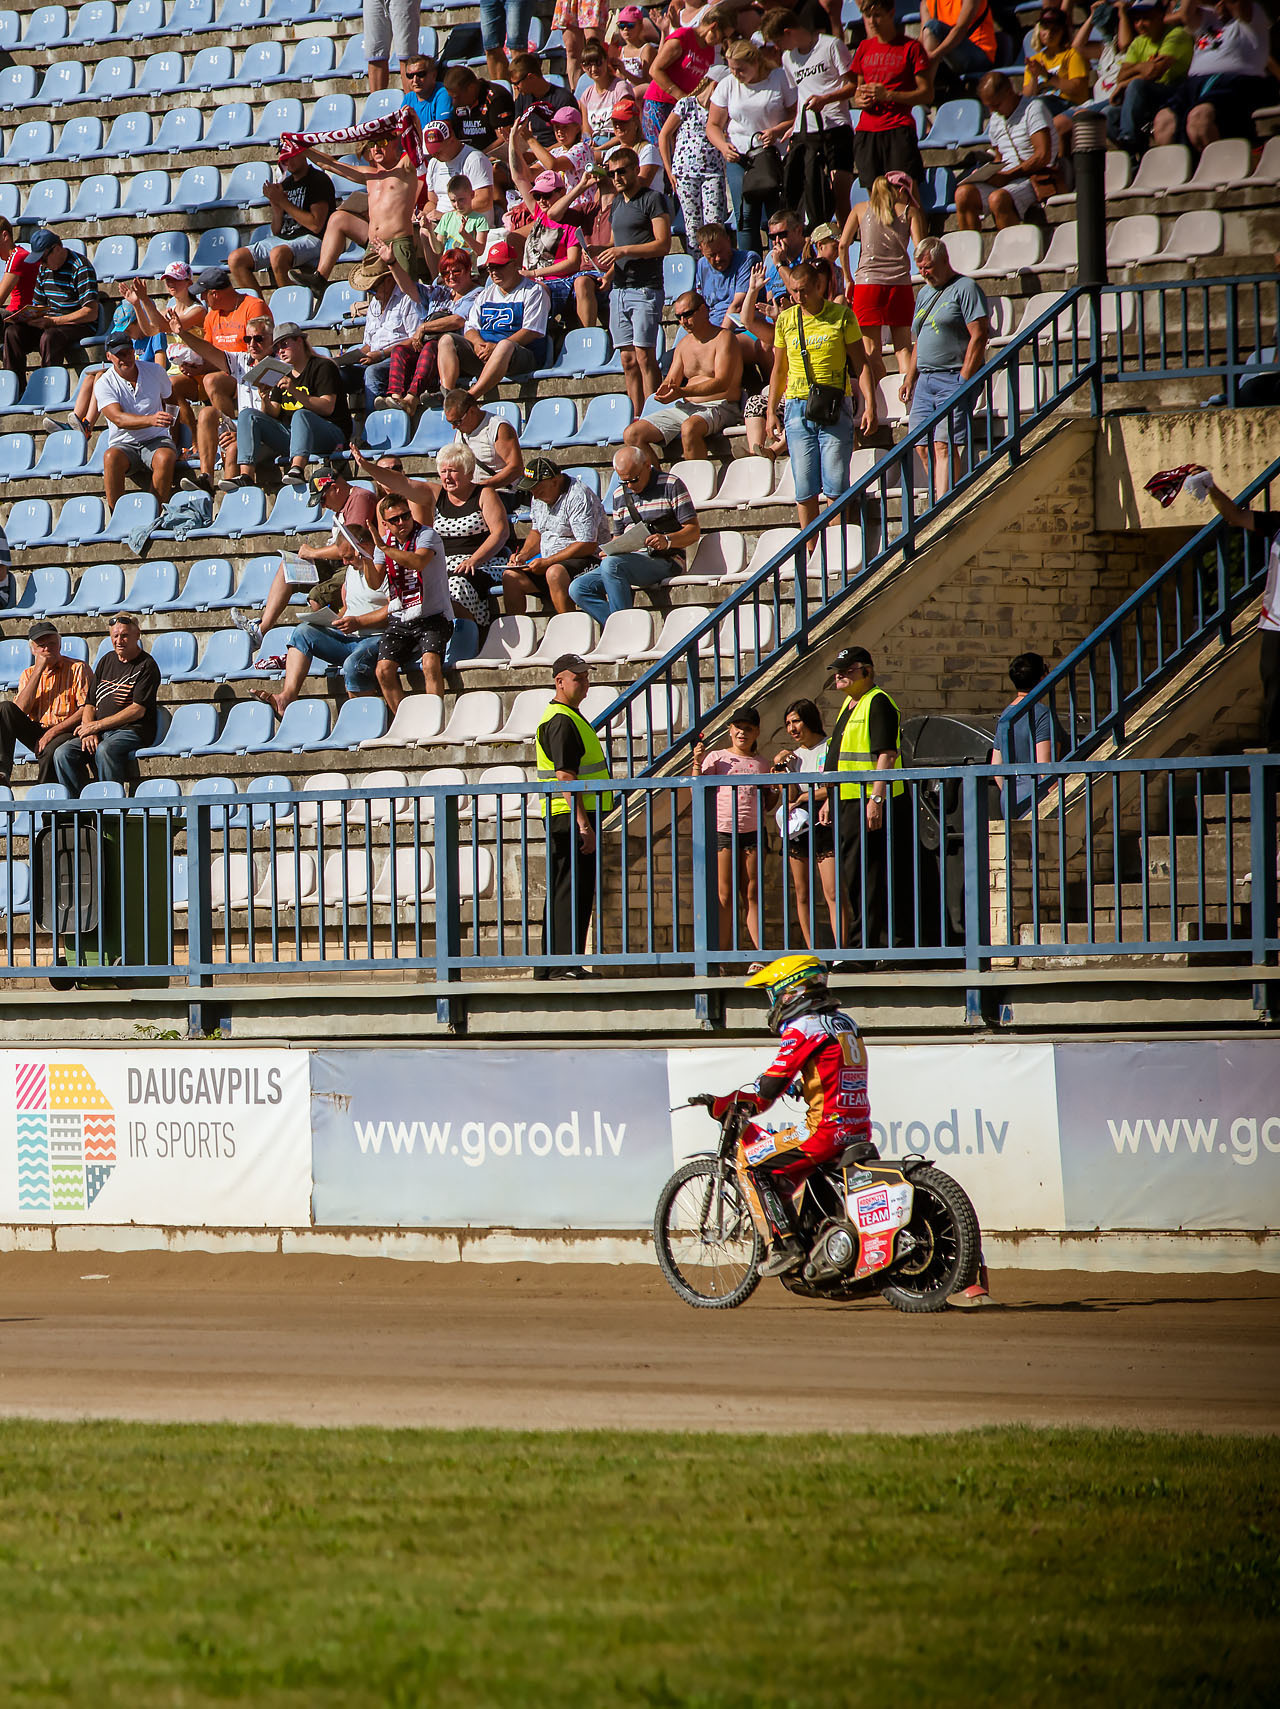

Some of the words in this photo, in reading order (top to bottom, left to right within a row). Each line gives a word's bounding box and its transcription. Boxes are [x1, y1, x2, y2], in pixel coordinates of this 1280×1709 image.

[482, 308, 514, 330] 72
[847, 1034, 861, 1064] 8
[128, 1068, 282, 1105] DAUGAVPILS
[129, 1122, 147, 1158] IR
[156, 1121, 236, 1159] SPORTS
[353, 1111, 626, 1167] www.gorod.lv
[860, 1208, 889, 1226] TEAM
